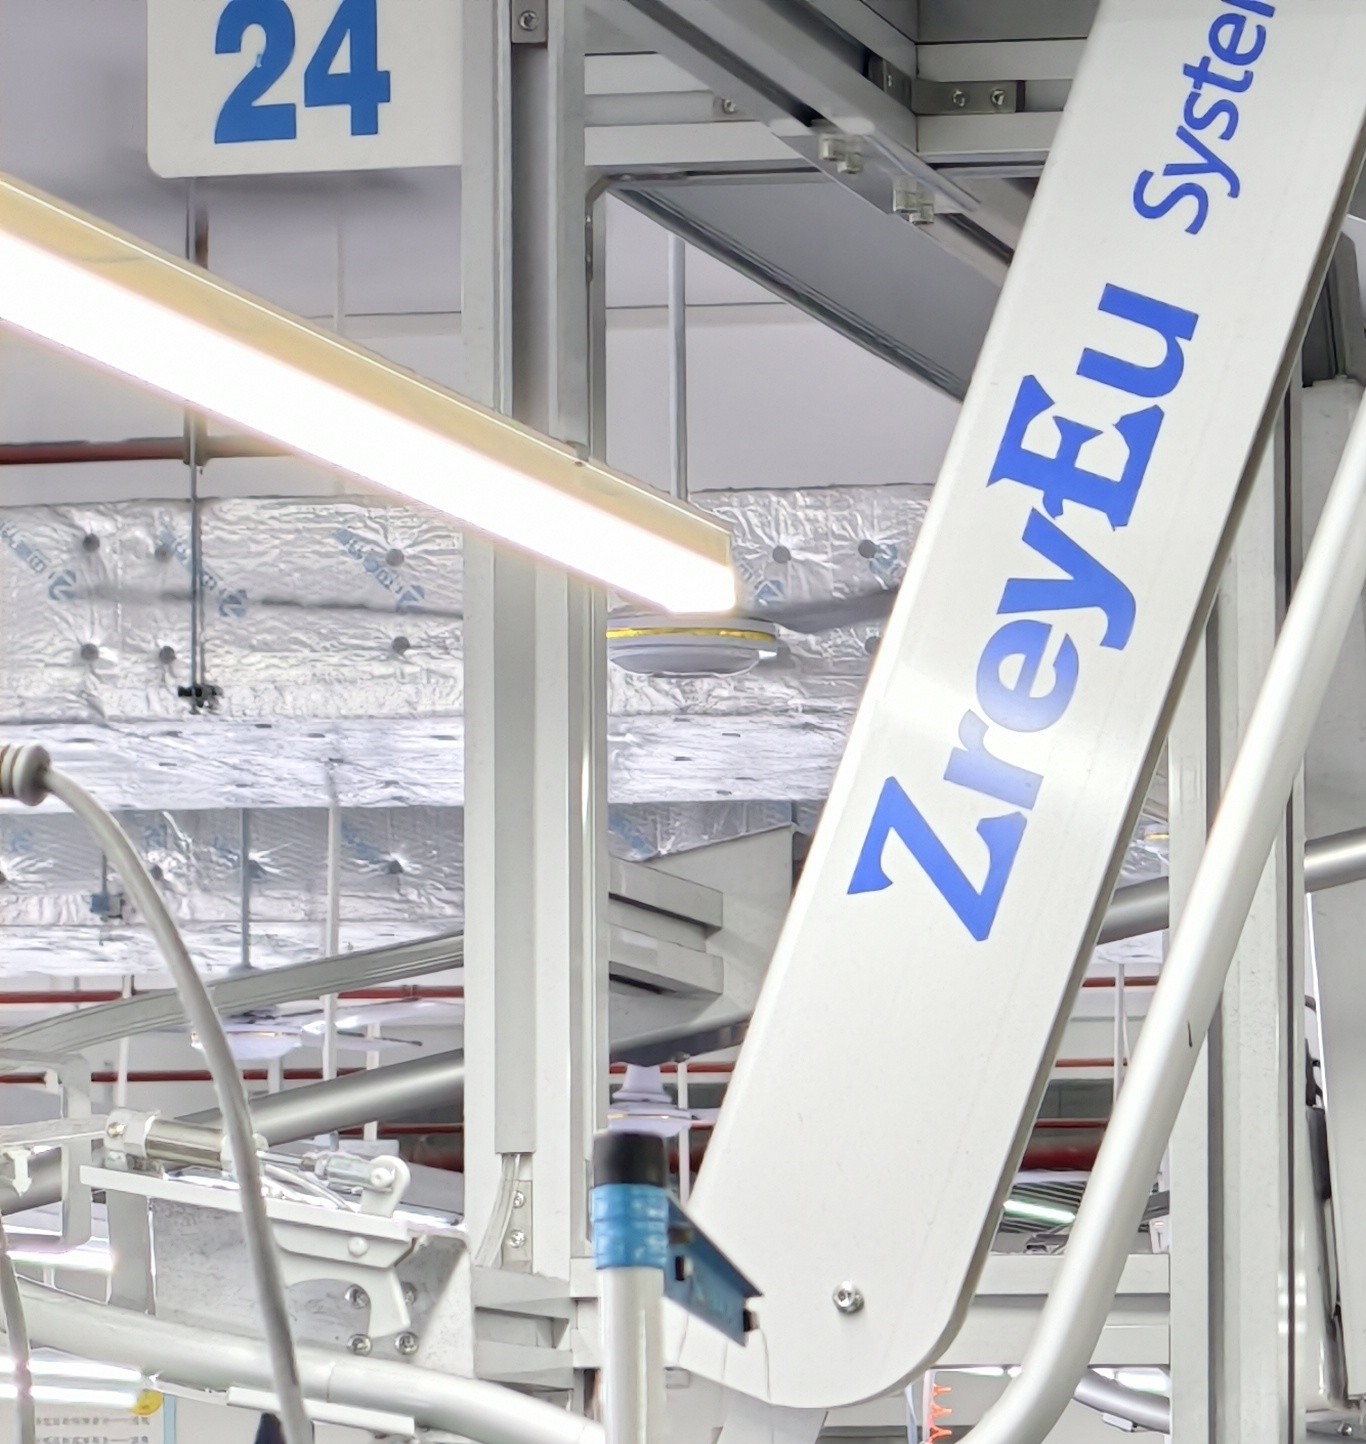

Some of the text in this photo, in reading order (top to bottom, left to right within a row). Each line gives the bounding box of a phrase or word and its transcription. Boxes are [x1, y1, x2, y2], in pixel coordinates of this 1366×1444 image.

[215, 0, 391, 143] 24
[848, 0, 1276, 942] ZreyEu Syste
